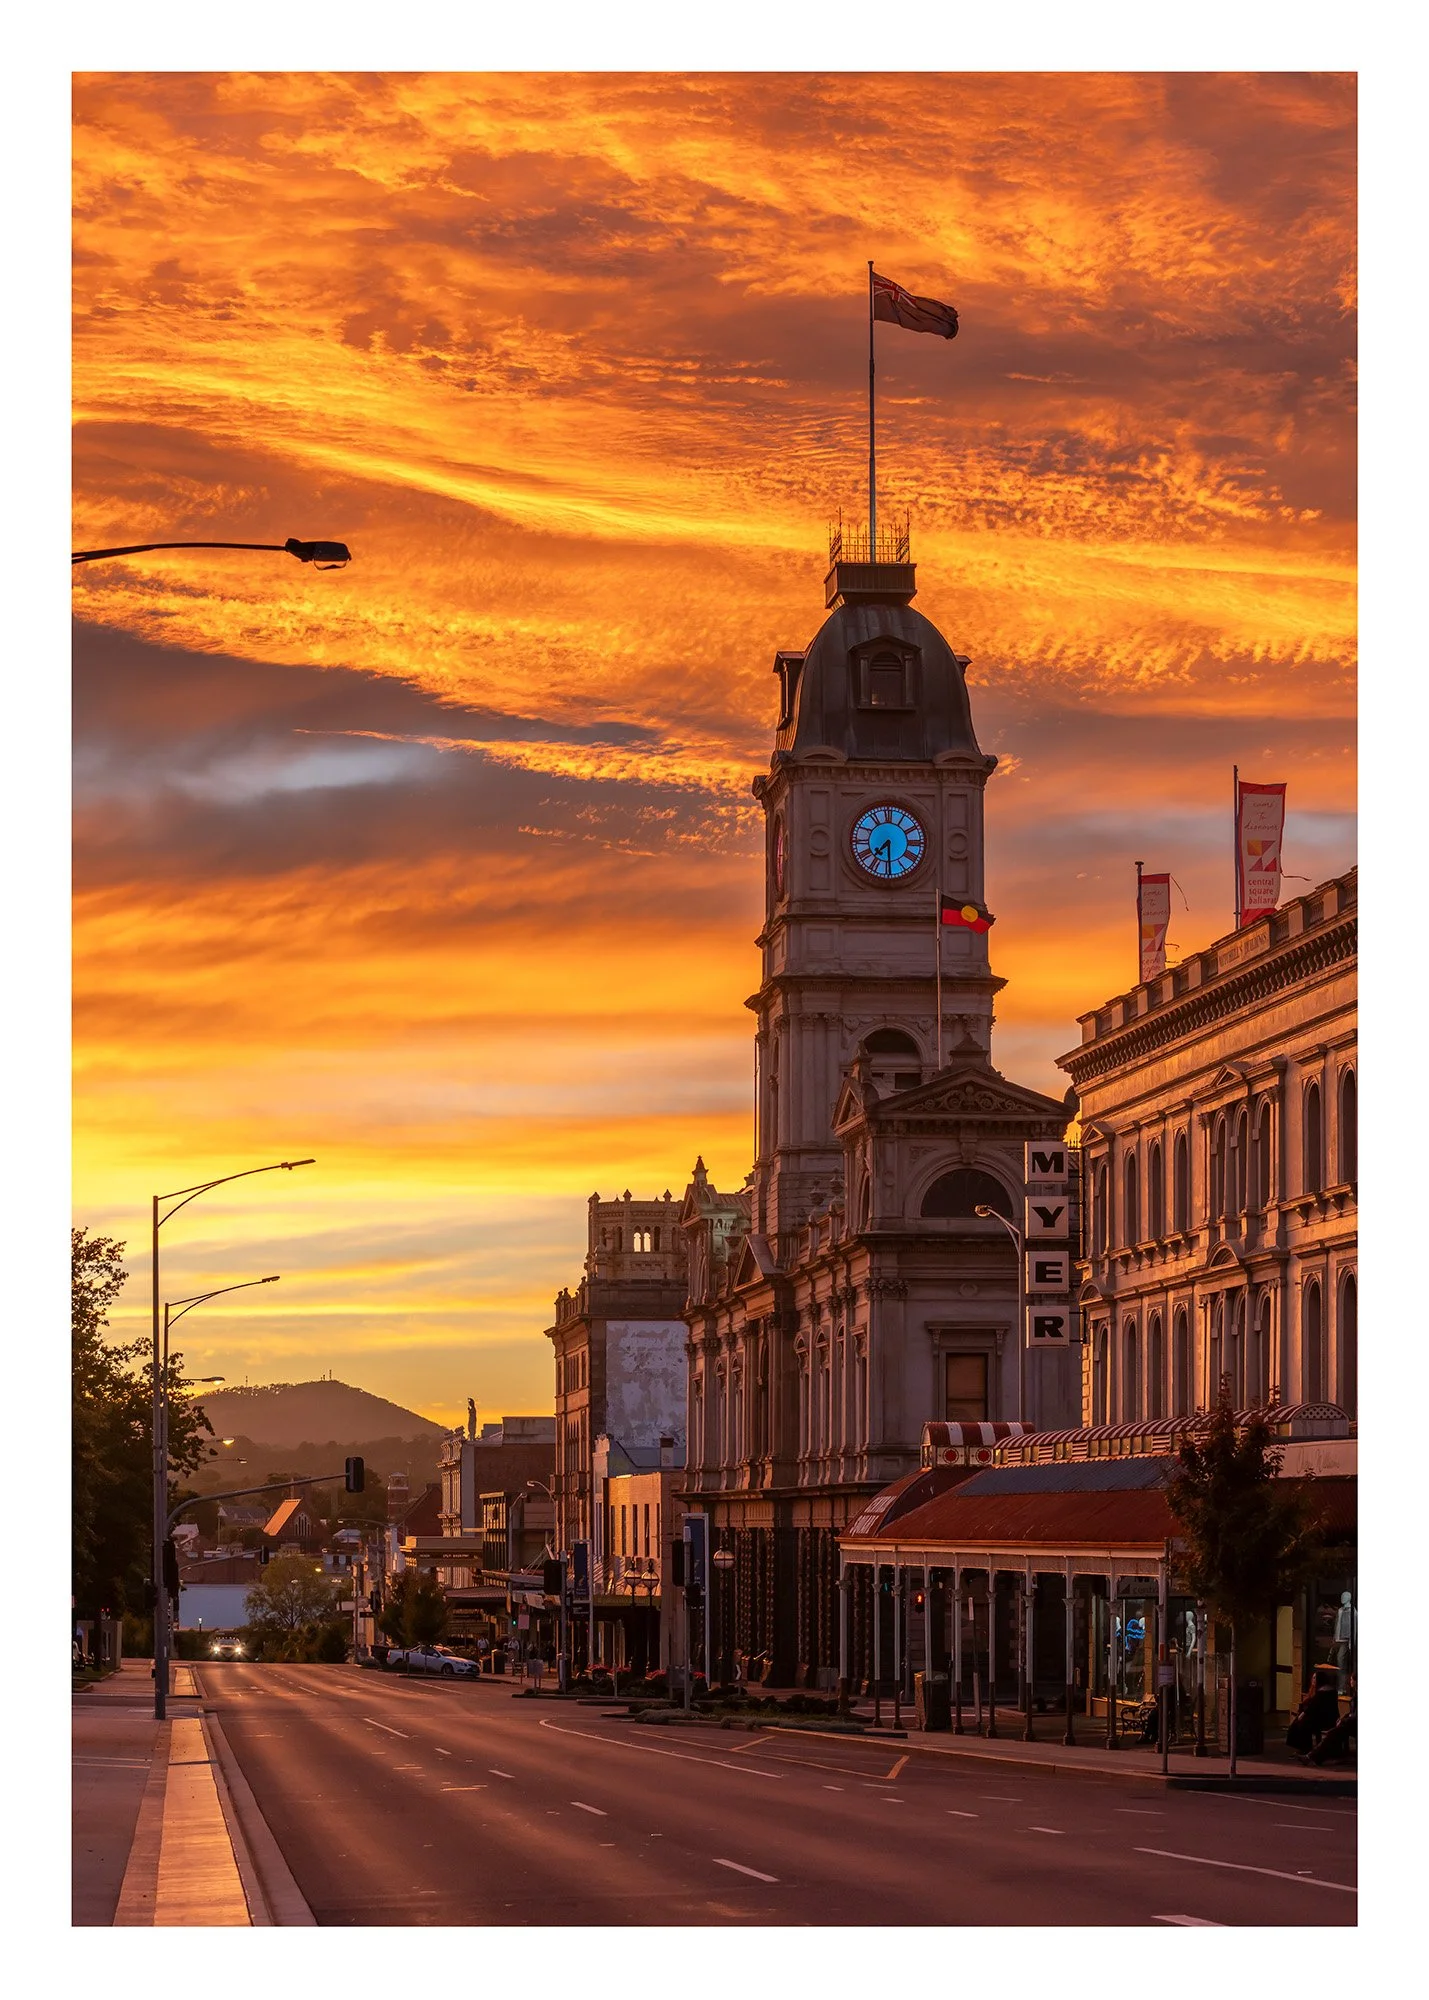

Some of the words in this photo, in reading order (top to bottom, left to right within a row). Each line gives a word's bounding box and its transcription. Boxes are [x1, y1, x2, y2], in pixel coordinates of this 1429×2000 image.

[1248, 878, 1274, 886] central
[1248, 887, 1274, 896] square
[1031, 1151, 1065, 1338] MYER
